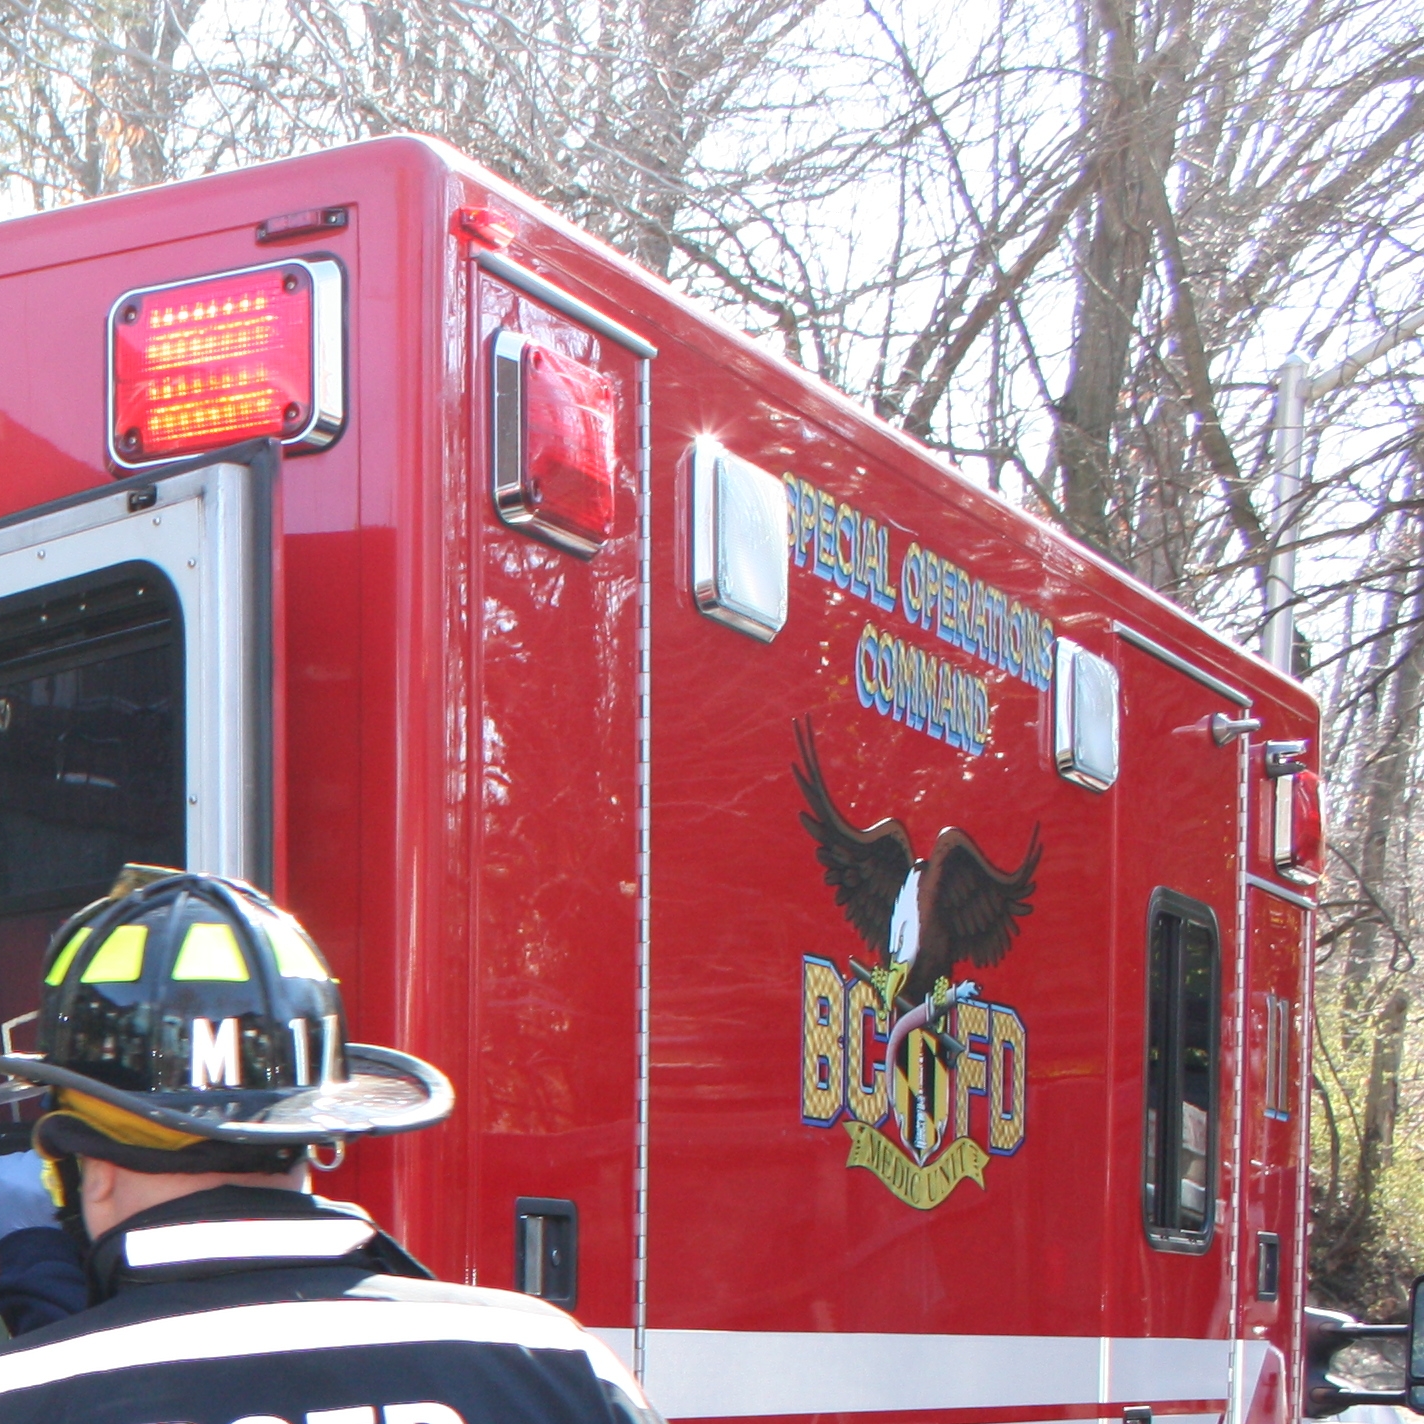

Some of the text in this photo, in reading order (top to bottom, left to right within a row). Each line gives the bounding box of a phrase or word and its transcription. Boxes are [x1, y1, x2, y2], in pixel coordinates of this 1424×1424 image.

[782, 471, 1053, 692] SPECIAL OPERATIONS
[855, 620, 990, 756] COMMAND
[192, 1017, 240, 1087] M
[801, 953, 1027, 1157] BCFD
[866, 1132, 967, 1204] MEDIC UNIT
